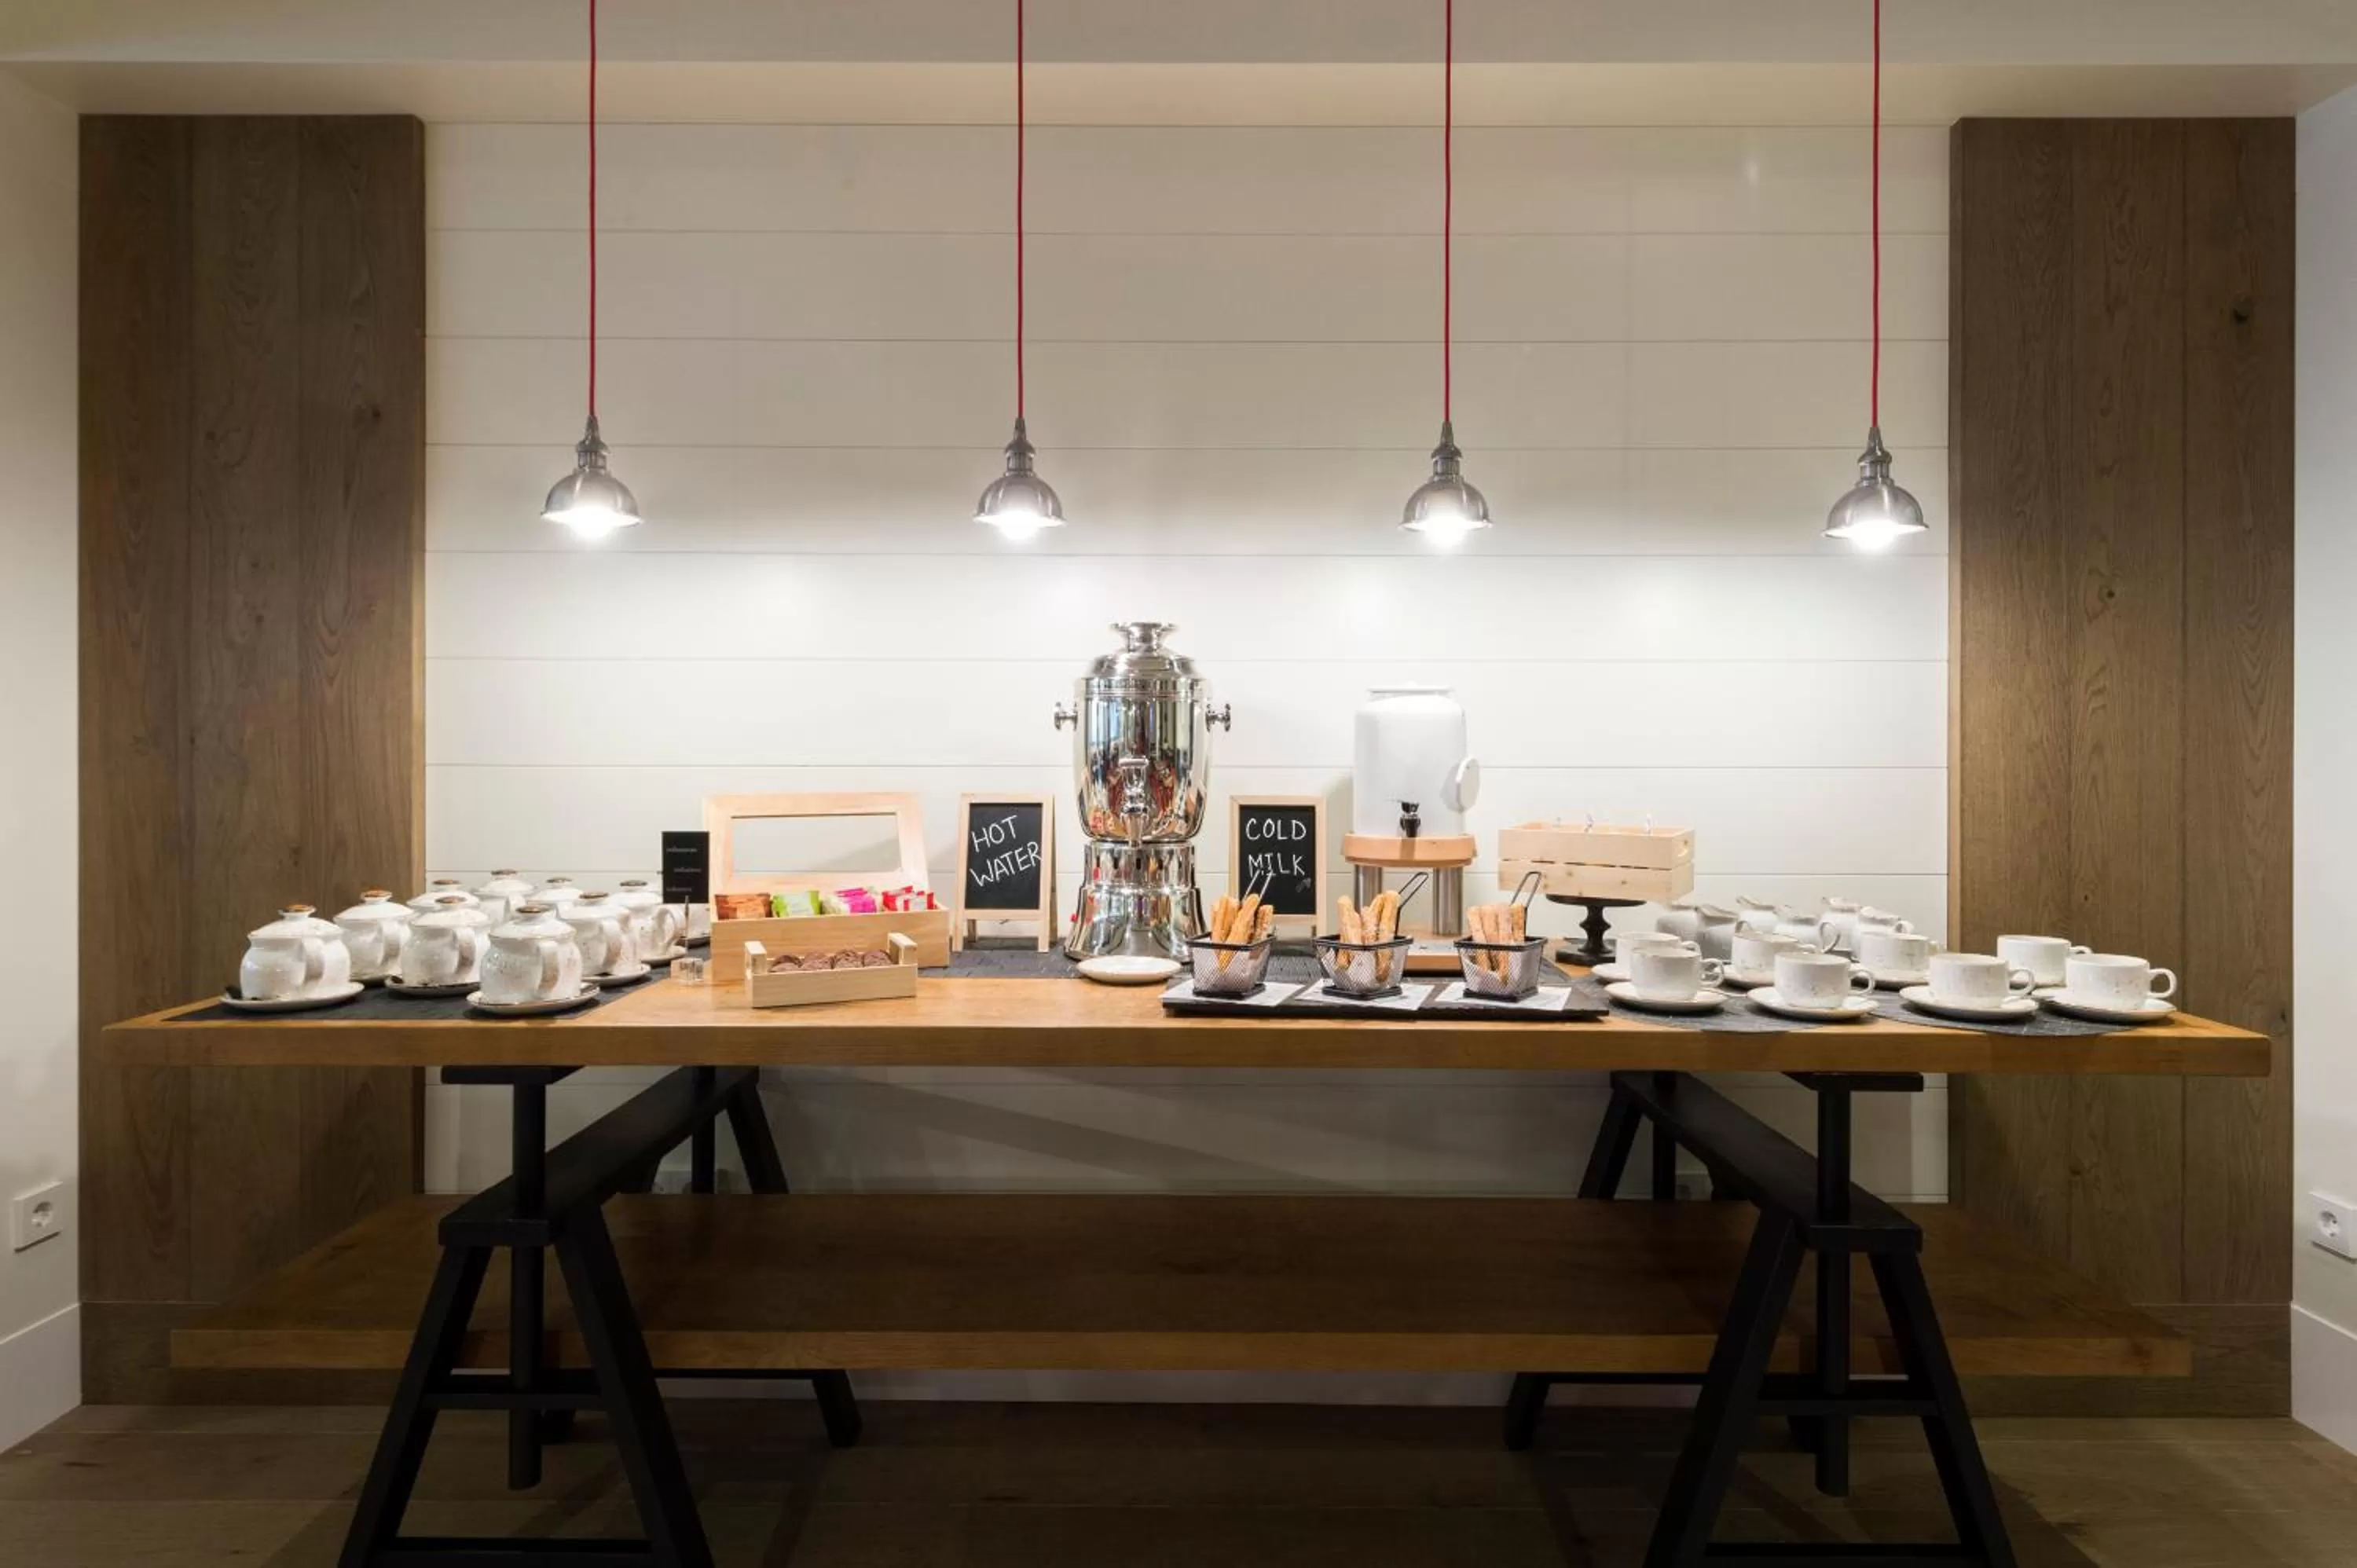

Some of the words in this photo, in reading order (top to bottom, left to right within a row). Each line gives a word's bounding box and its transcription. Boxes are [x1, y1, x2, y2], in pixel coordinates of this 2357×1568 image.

[971, 815, 1017, 852] HOT
[1245, 818, 1307, 840] COLD
[969, 841, 1043, 887] WATER
[1248, 852, 1306, 877] MILK
